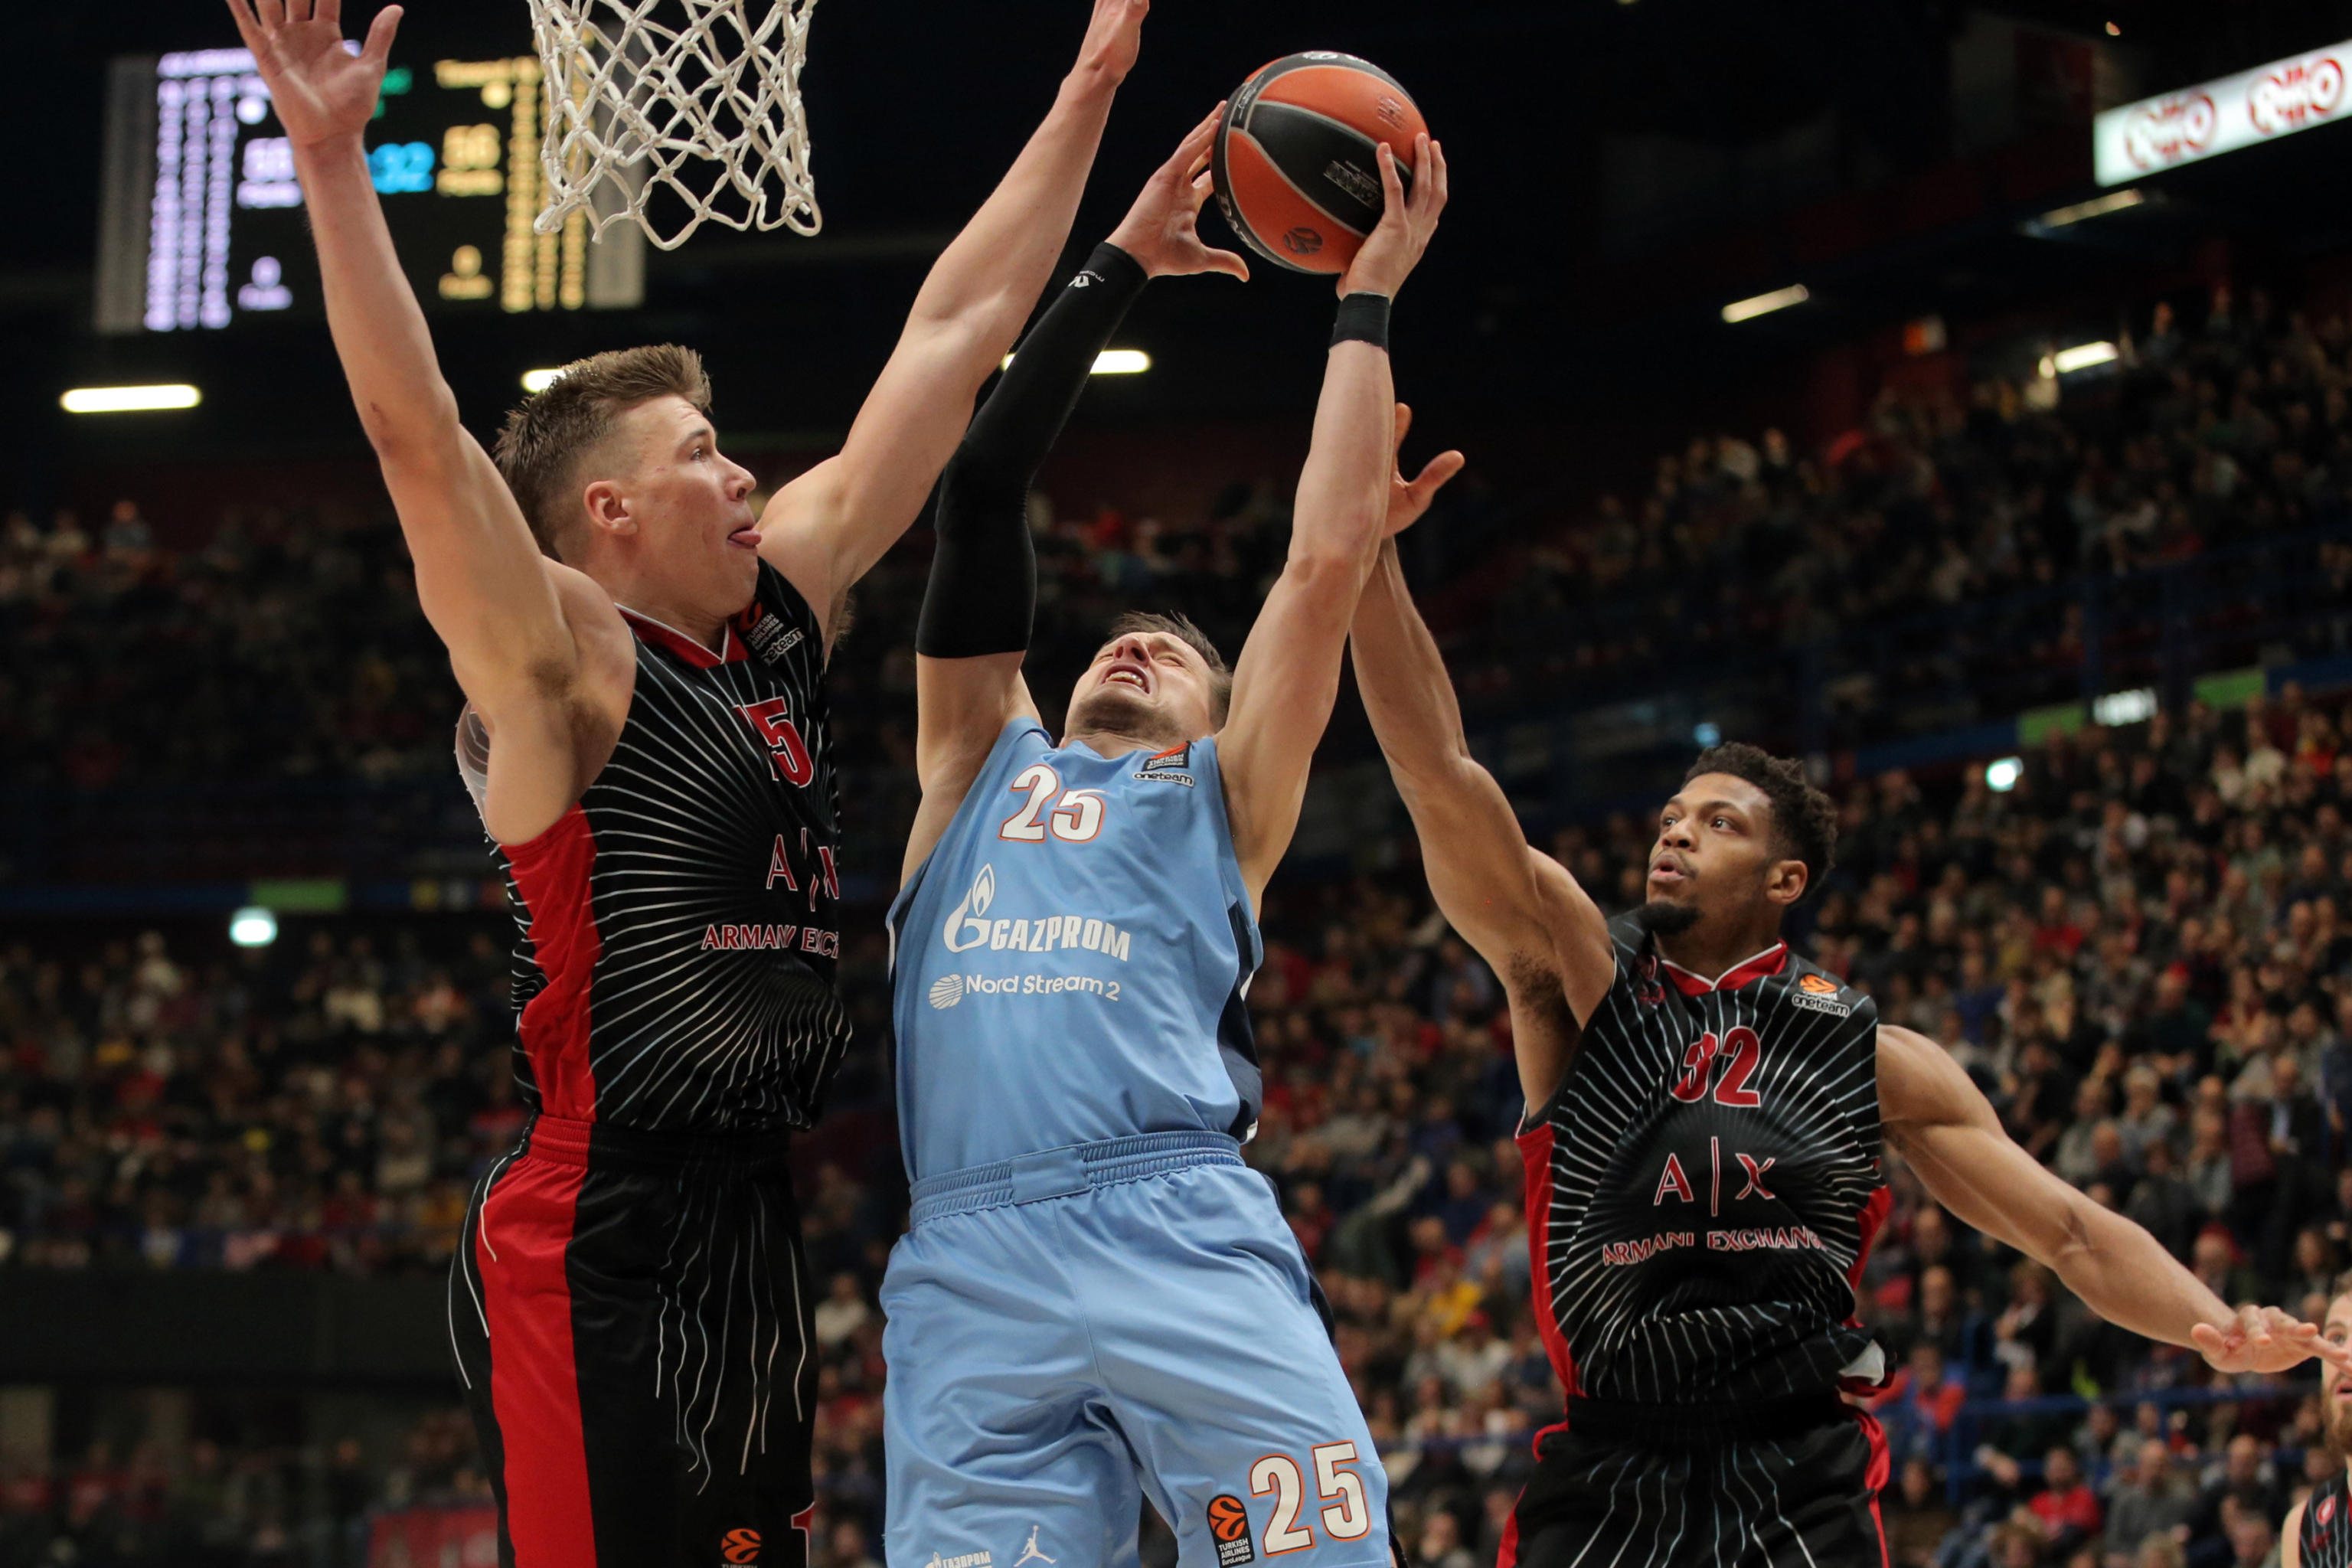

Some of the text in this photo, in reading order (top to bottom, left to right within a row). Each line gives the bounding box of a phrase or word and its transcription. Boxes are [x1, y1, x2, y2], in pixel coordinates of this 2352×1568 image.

[762, 627, 805, 667] neteam
[1133, 772, 1194, 787] oneteam
[998, 763, 1106, 843] 25
[990, 916, 1131, 962] GAZPROM
[966, 974, 1121, 1001] Nord Stream 2
[1792, 994, 1851, 1018] oneteam
[1671, 1026, 1761, 1108] 32
[1602, 1232, 1694, 1266] ARMANI
[1249, 1439, 1372, 1557] 25
[1219, 1537, 1249, 1552] TURKISH
[1220, 1546, 1250, 1559] AIRLINES
